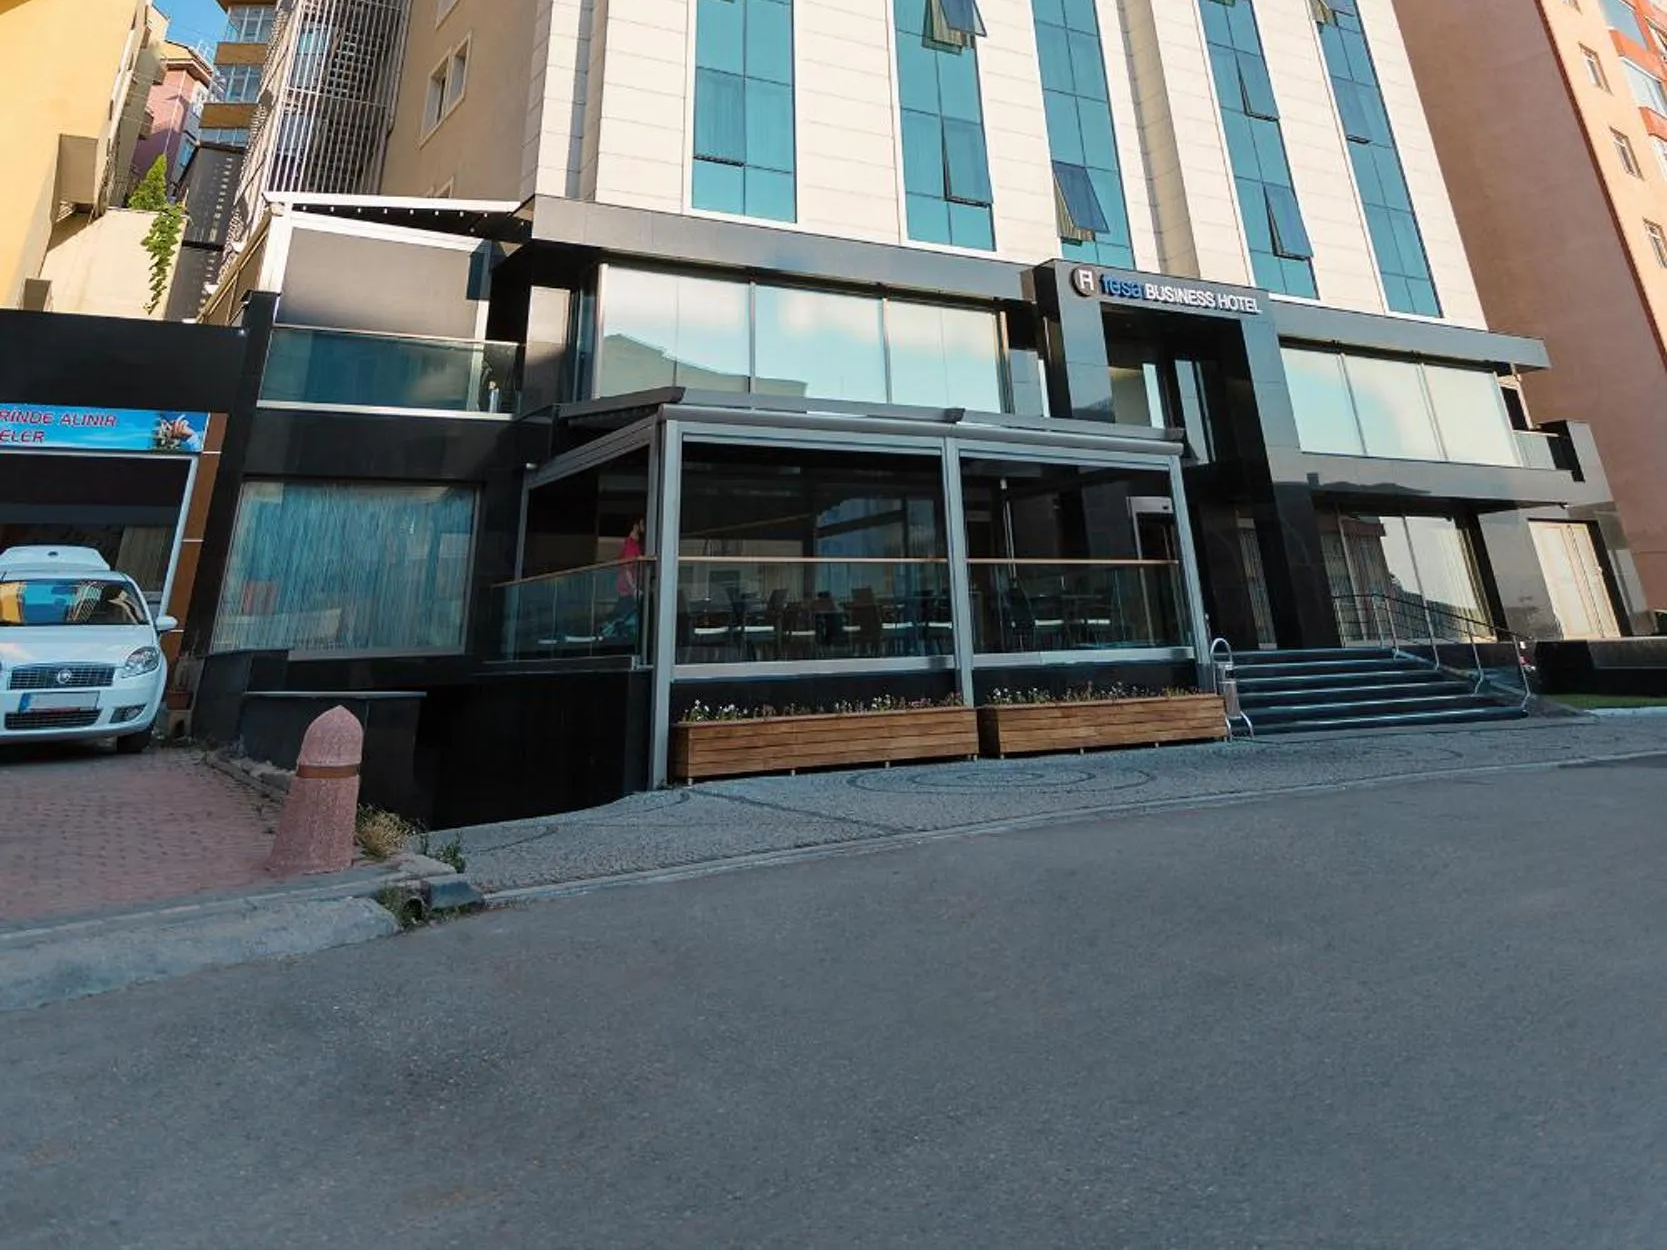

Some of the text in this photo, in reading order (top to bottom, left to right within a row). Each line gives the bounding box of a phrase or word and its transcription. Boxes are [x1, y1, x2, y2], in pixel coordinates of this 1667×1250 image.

[1100, 275, 1141, 297] fesa
[1144, 283, 1215, 308] BUSINESS
[1216, 293, 1261, 314] HOTEL
